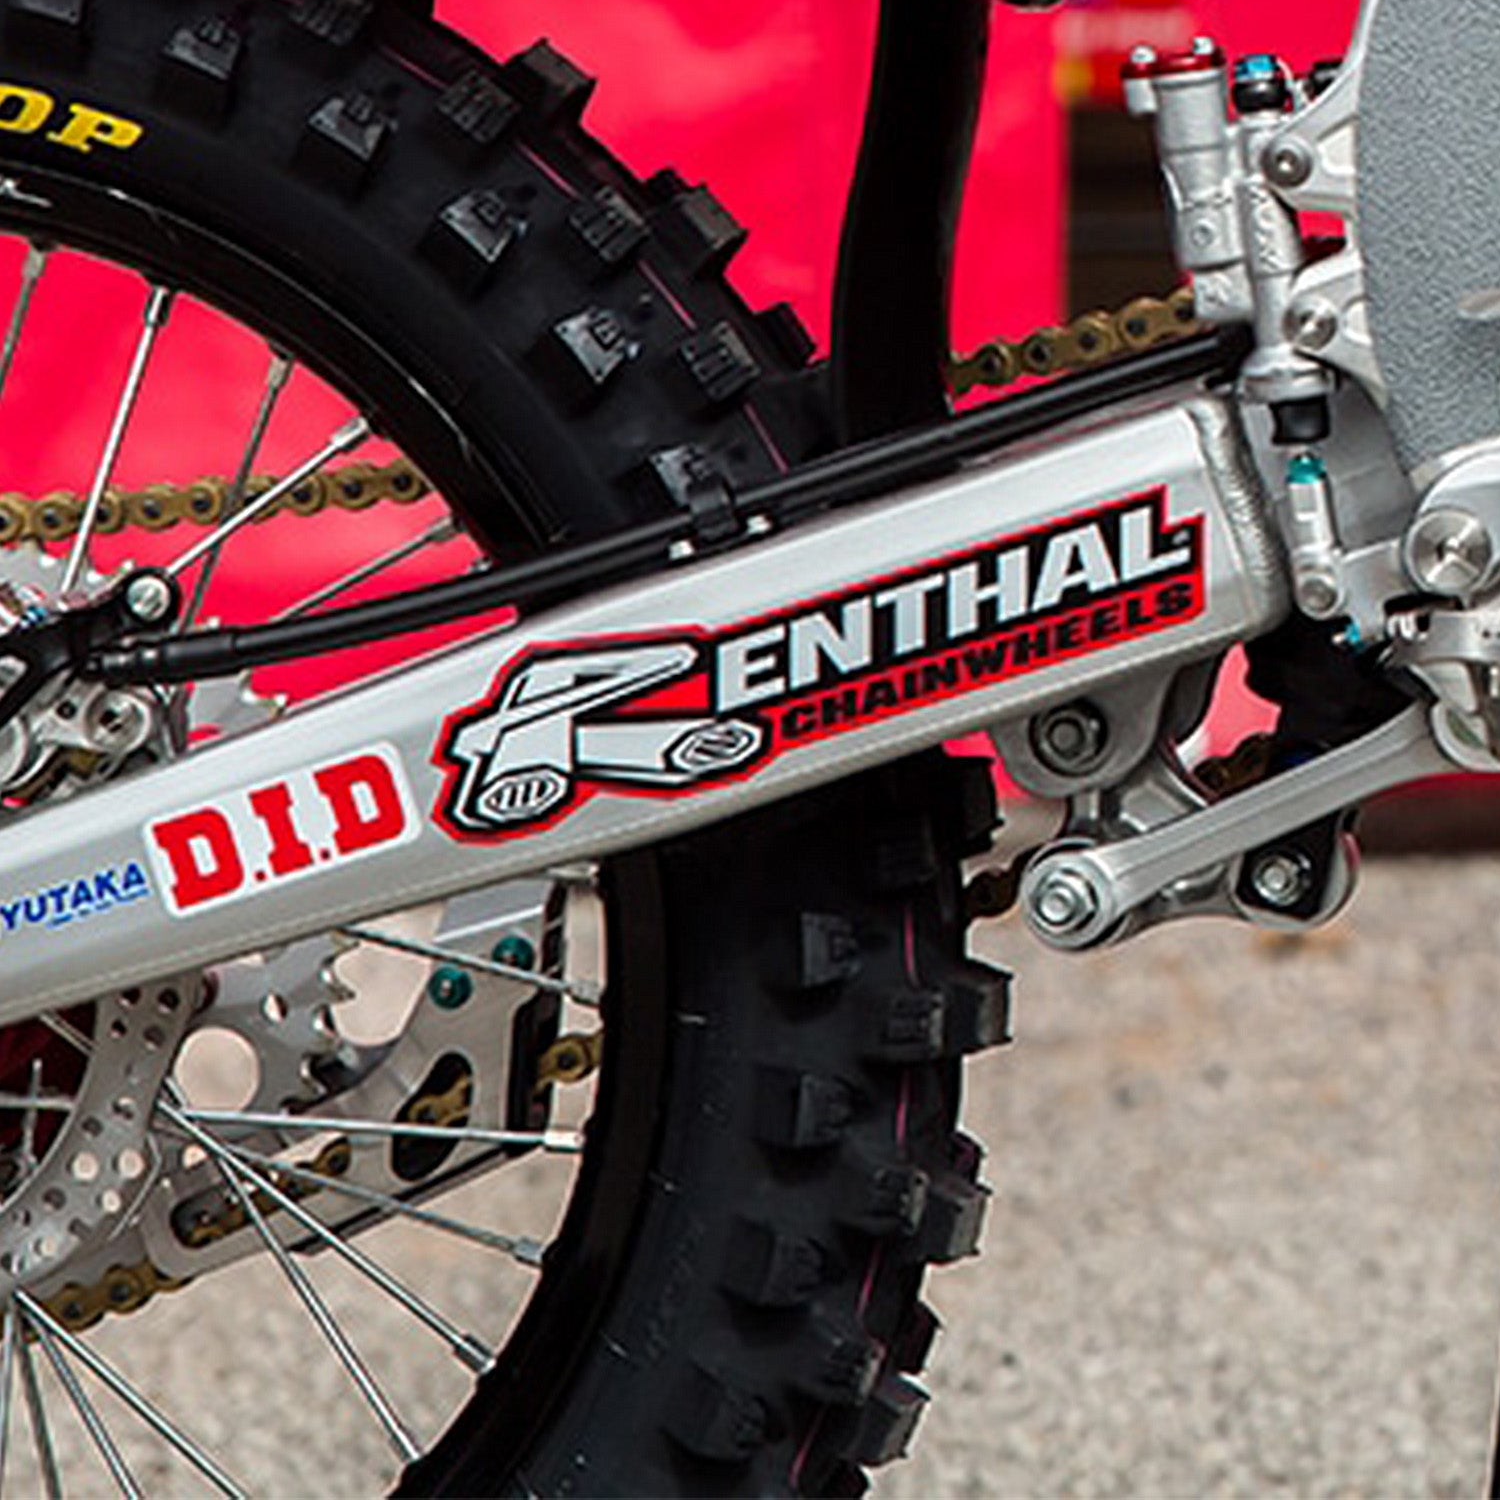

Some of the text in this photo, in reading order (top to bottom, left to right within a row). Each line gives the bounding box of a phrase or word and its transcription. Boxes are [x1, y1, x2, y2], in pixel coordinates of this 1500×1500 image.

[780, 580, 1195, 740] CHAINWHEELS
[0, 863, 147, 930] YUTAKA
[153, 754, 406, 910] D.I.D
